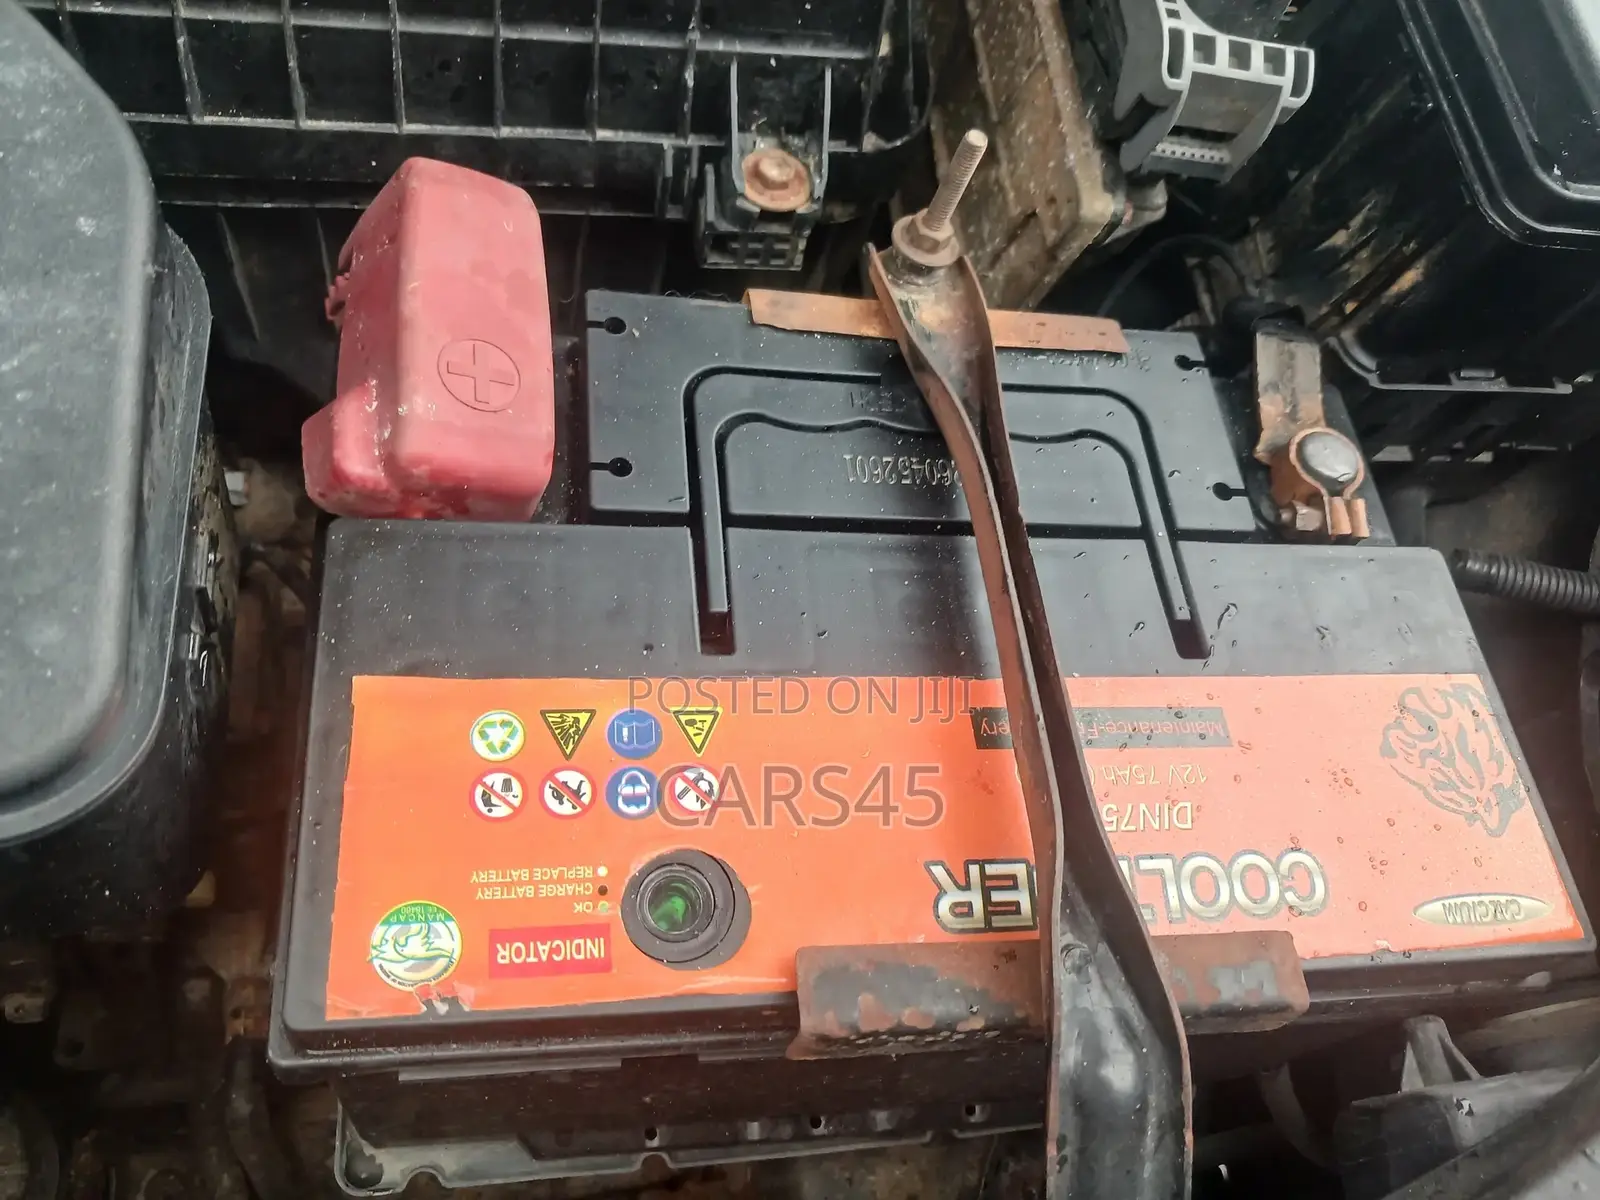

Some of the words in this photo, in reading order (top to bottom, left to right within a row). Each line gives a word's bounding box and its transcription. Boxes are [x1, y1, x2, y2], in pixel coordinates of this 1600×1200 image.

[1103, 764, 1160, 786] 75Ah
[1167, 764, 1208, 785] 12V
[470, 868, 530, 883] BATTERY
[532, 865, 593, 880] REPLACE
[476, 885, 534, 900] BATTERY
[538, 883, 593, 898] CHARGE
[573, 901, 593, 913] OK
[390, 912, 445, 923] MANCAP
[496, 937, 605, 965] INDICATOR
